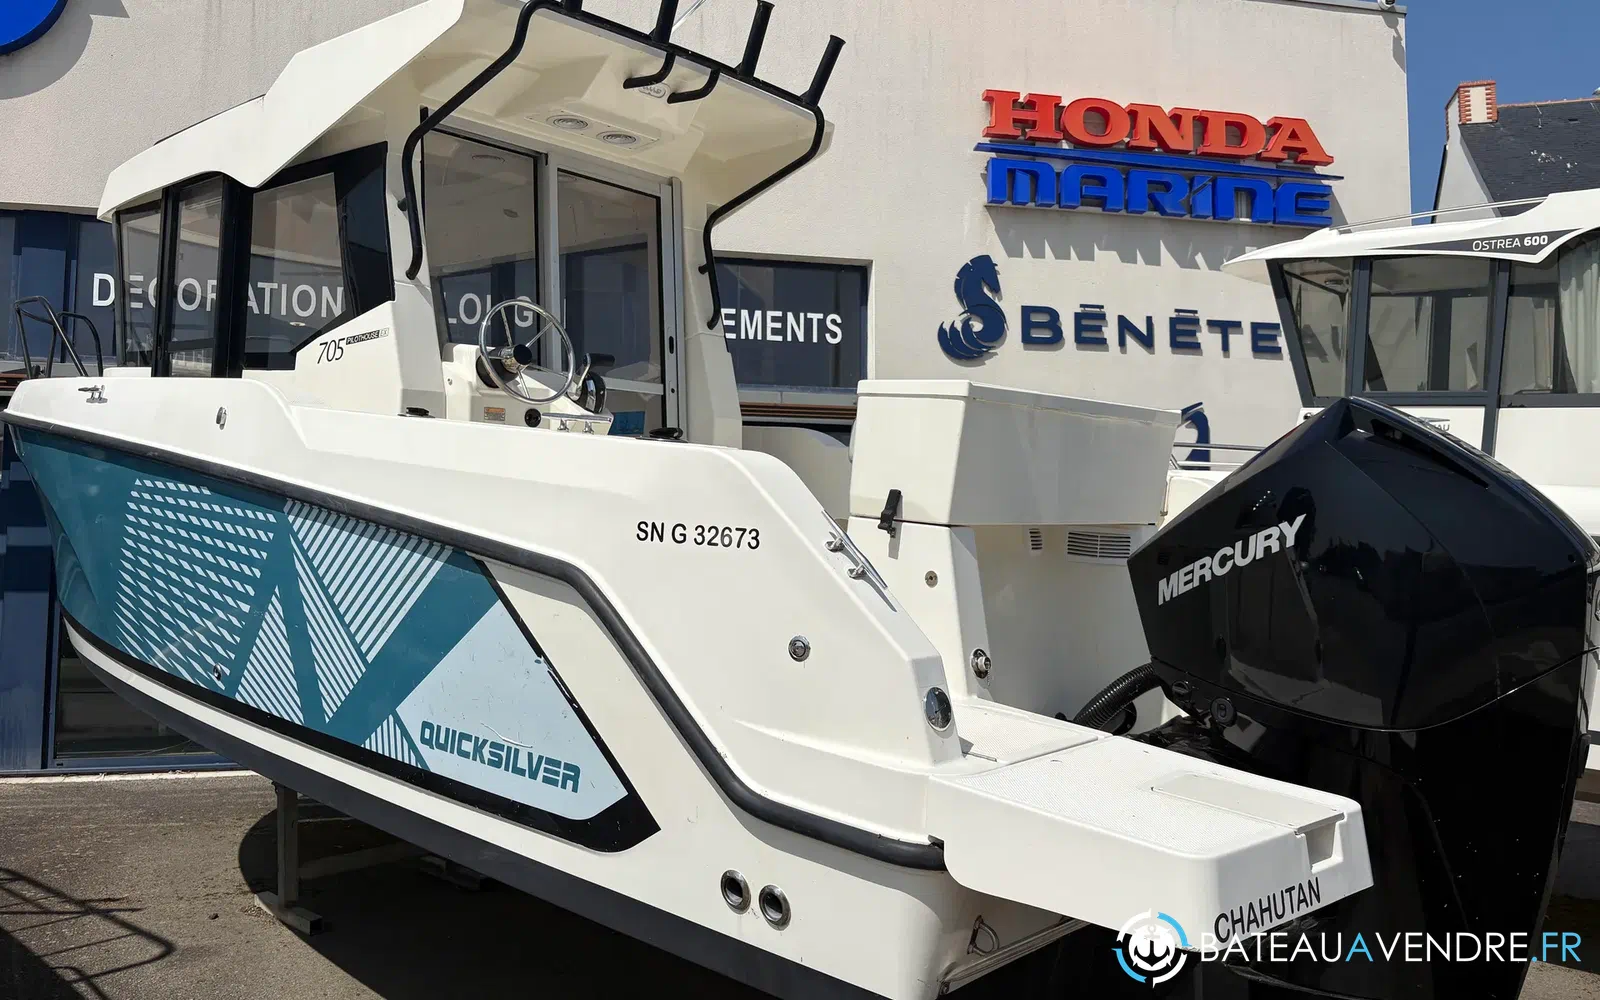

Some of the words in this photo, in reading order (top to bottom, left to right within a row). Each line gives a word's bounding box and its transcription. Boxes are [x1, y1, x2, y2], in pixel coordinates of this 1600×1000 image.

[982, 89, 1334, 167] HONDA
[987, 157, 1333, 228] MARINE
[1472, 238, 1521, 252] OSTREA
[1523, 235, 1548, 247] 600
[317, 338, 345, 364] 705
[346, 330, 379, 345] PILOTHOUSE
[636, 521, 665, 543] SN
[671, 523, 687, 544] G
[693, 524, 760, 550] 32673
[1158, 513, 1307, 606] MERCURY
[420, 720, 581, 793] QUICKSILVER
[1214, 876, 1321, 943] CHAHUTAN
